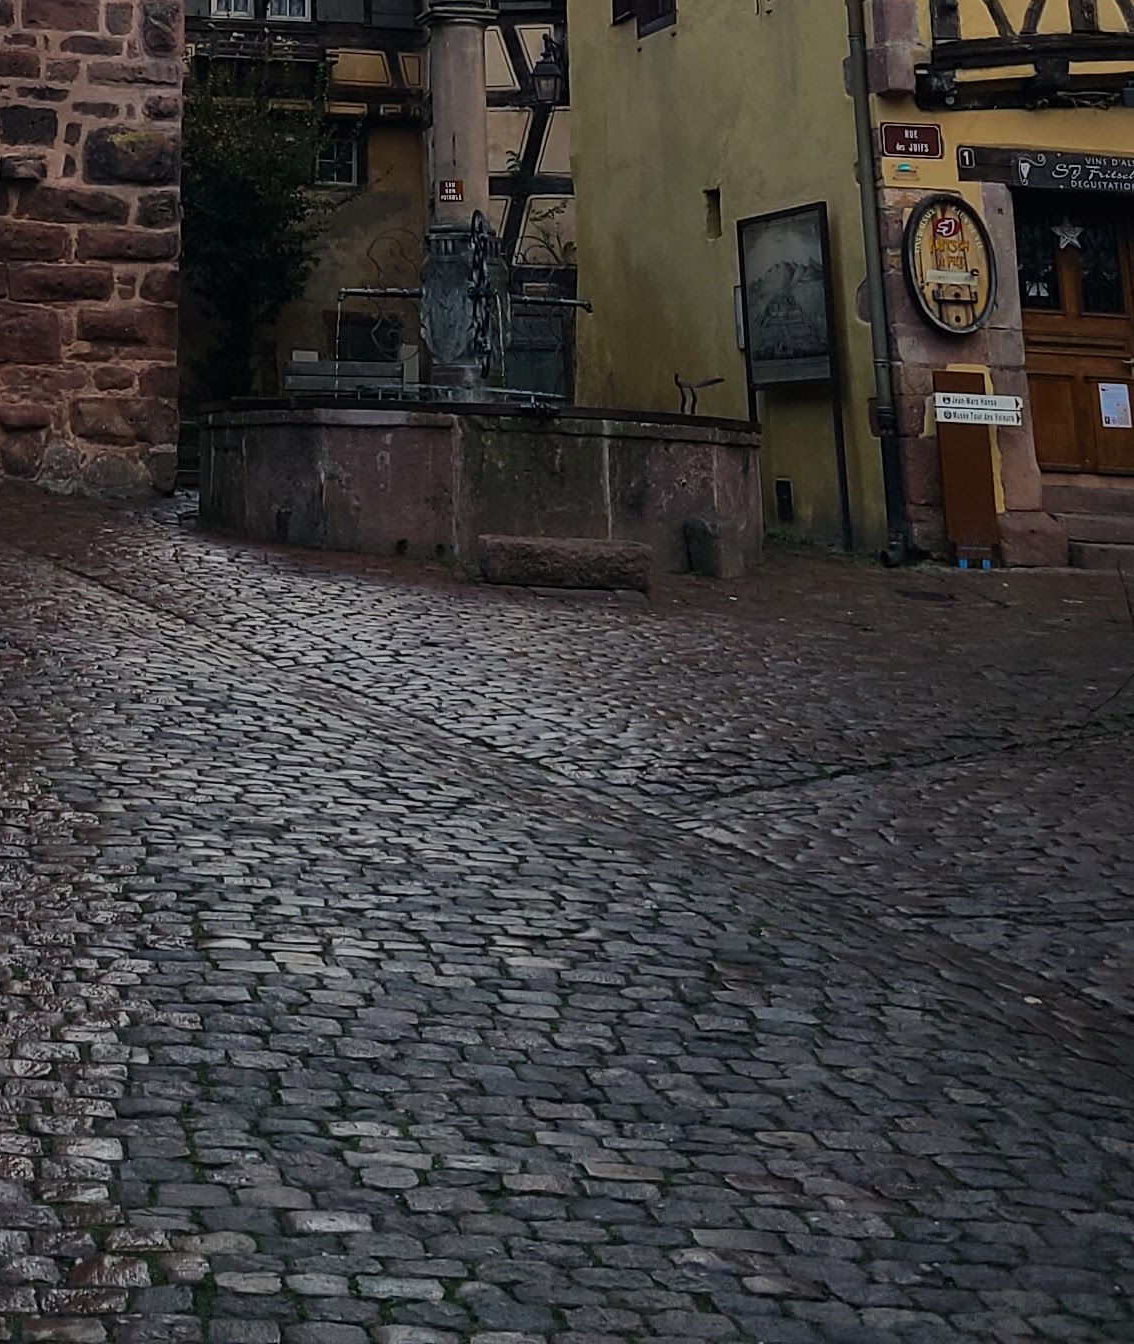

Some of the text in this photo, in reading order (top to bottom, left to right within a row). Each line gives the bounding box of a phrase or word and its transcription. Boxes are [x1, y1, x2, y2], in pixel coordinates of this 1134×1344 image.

[904, 129, 918, 139] RUE
[895, 142, 929, 153] des JUIFS
[963, 150, 970, 165] 1
[1084, 157, 1107, 166] VINS
[970, 412, 983, 421] Tour
